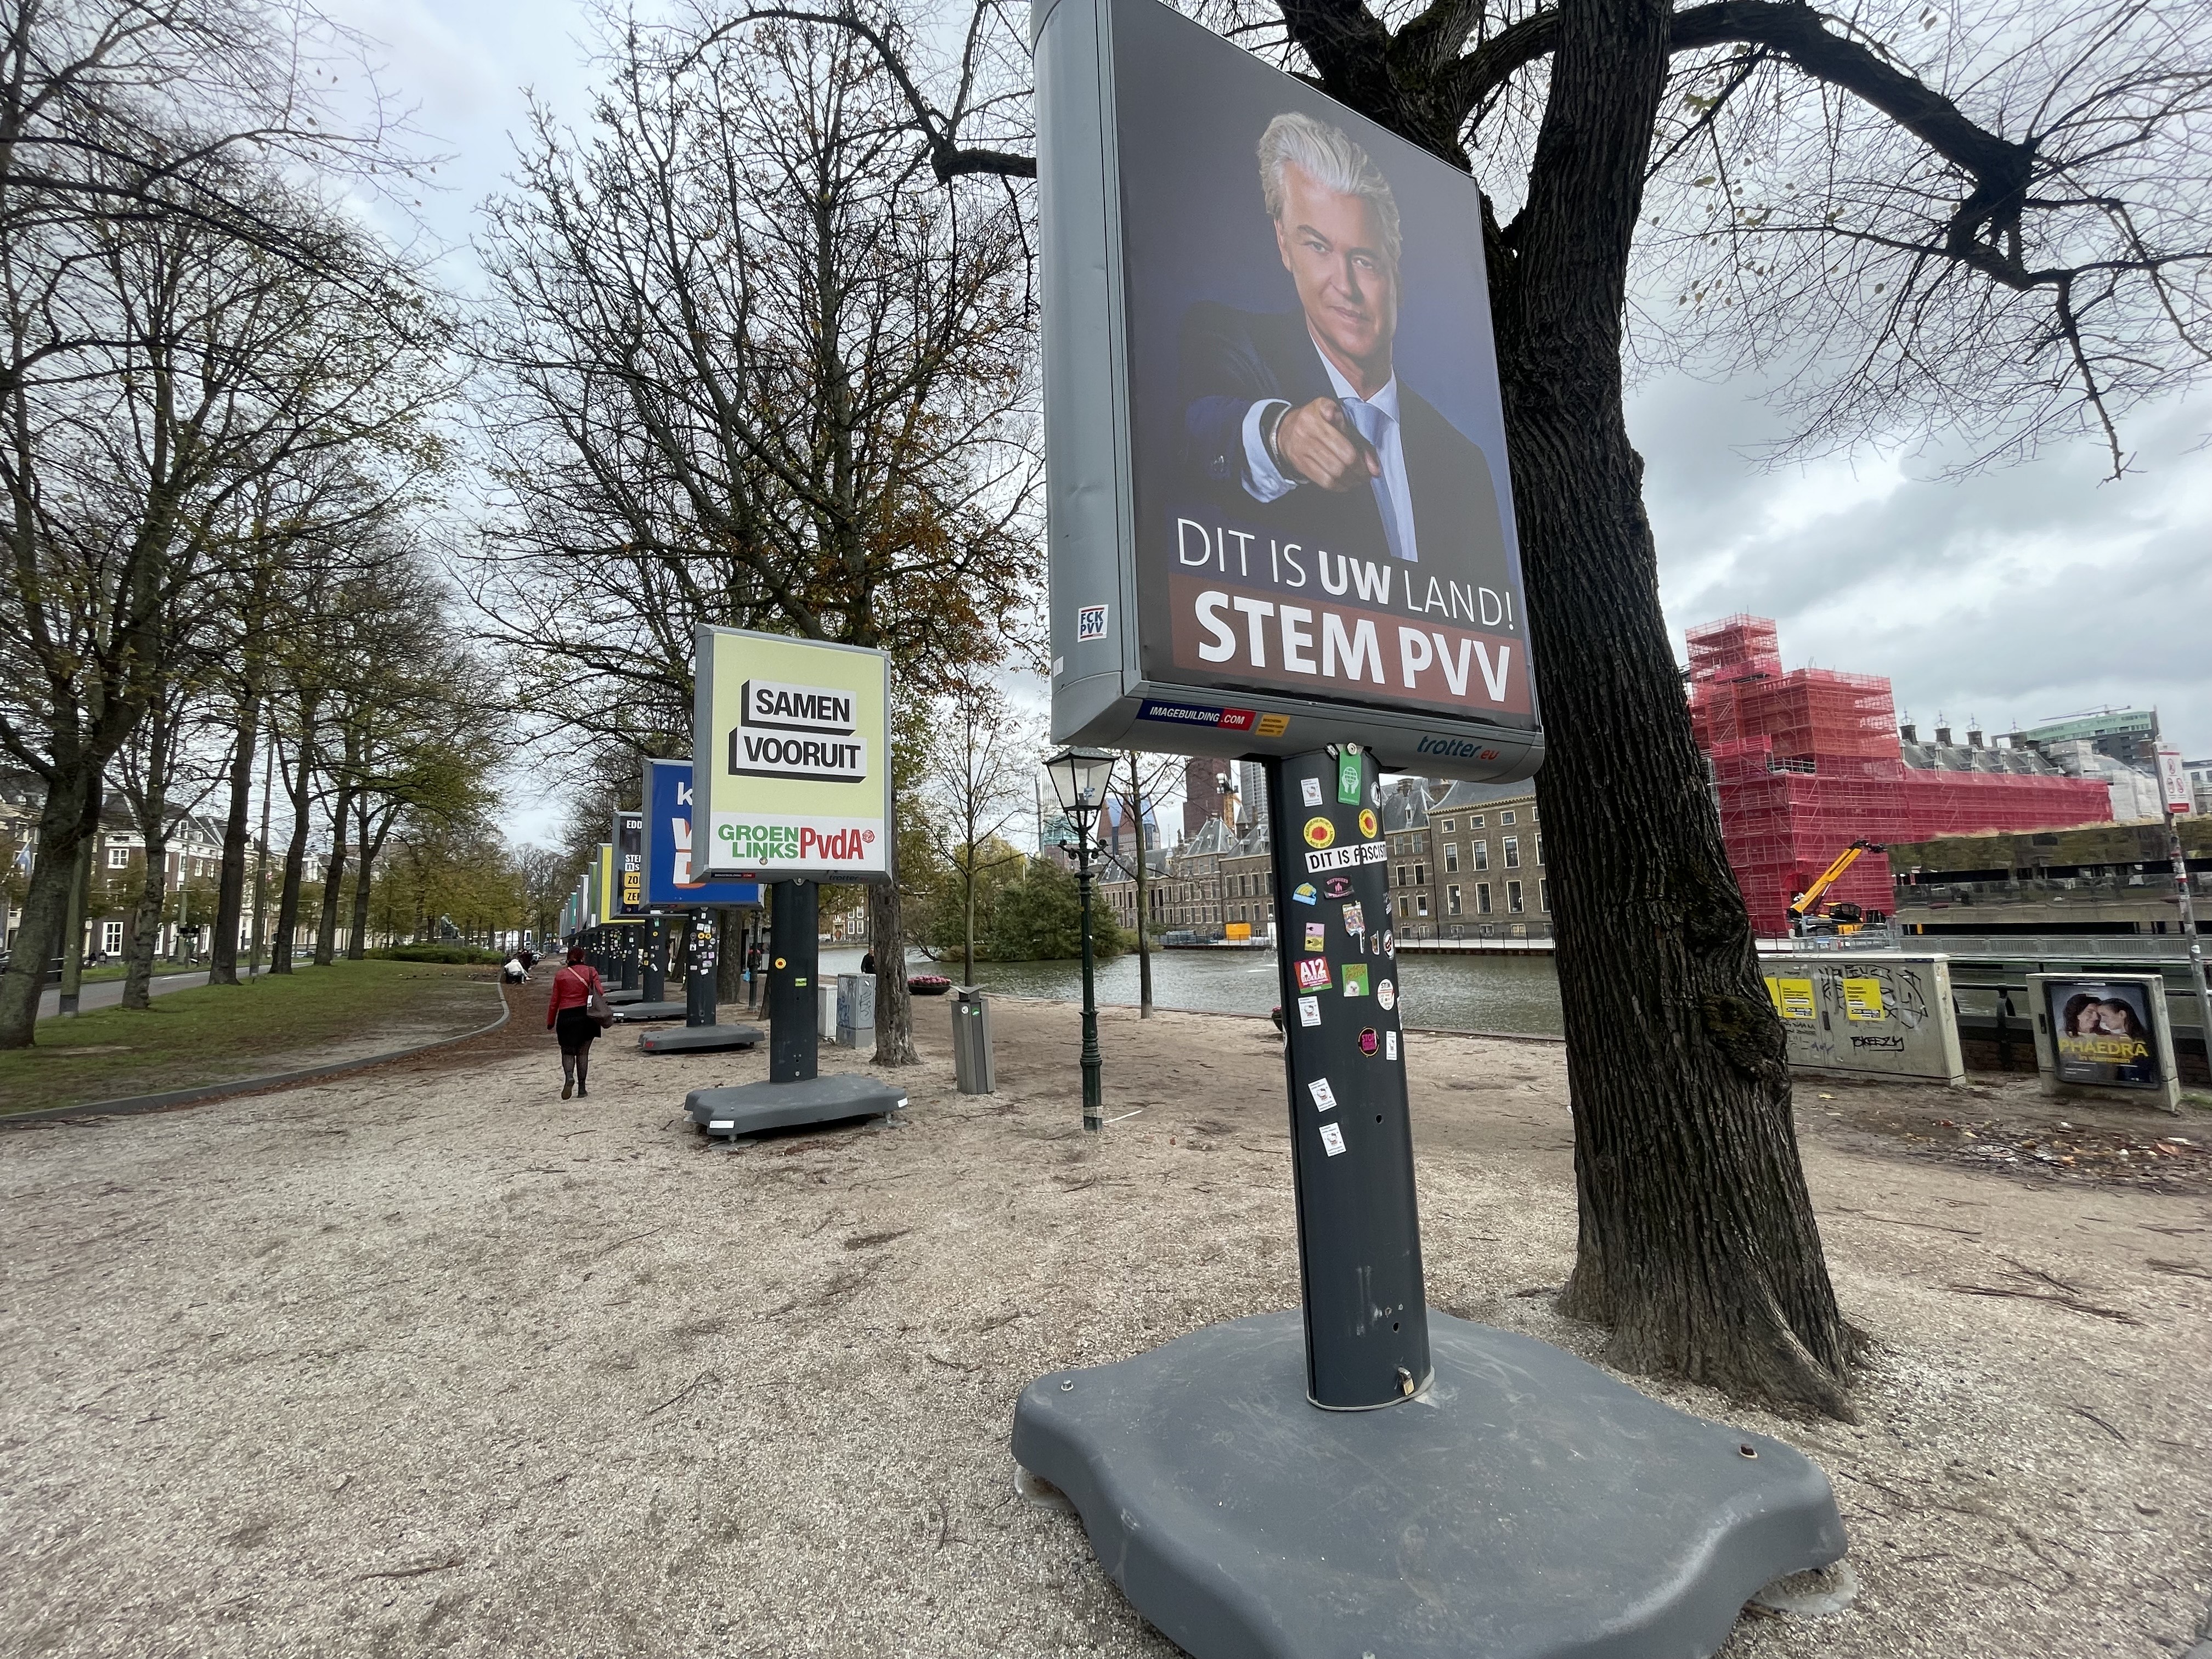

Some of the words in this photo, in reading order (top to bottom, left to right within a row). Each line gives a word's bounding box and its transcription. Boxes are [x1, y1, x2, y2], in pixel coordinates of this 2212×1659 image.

[1178, 518, 1255, 577] DIT
[1272, 539, 1306, 588] IS
[1318, 550, 1391, 605] UW
[1404, 569, 1514, 630] LAND!
[1081, 611, 1104, 624] FCK
[1080, 622, 1104, 635] PVV
[1195, 591, 1385, 685] STEM
[1398, 626, 1510, 702] PVV
[756, 688, 850, 723] SAMEN
[744, 735, 861, 770] VOORUIT
[1417, 735, 1500, 760] trotter.eu
[718, 824, 799, 842] GROEN
[732, 842, 799, 859] LINKS
[800, 827, 865, 860] PvdA
[1309, 852, 1332, 870] DIT
[1338, 850, 1350, 865] IS
[628, 876, 640, 884] ZO
[1300, 958, 1327, 977] A12
[2058, 1038, 2149, 1057] PHAEDRA
